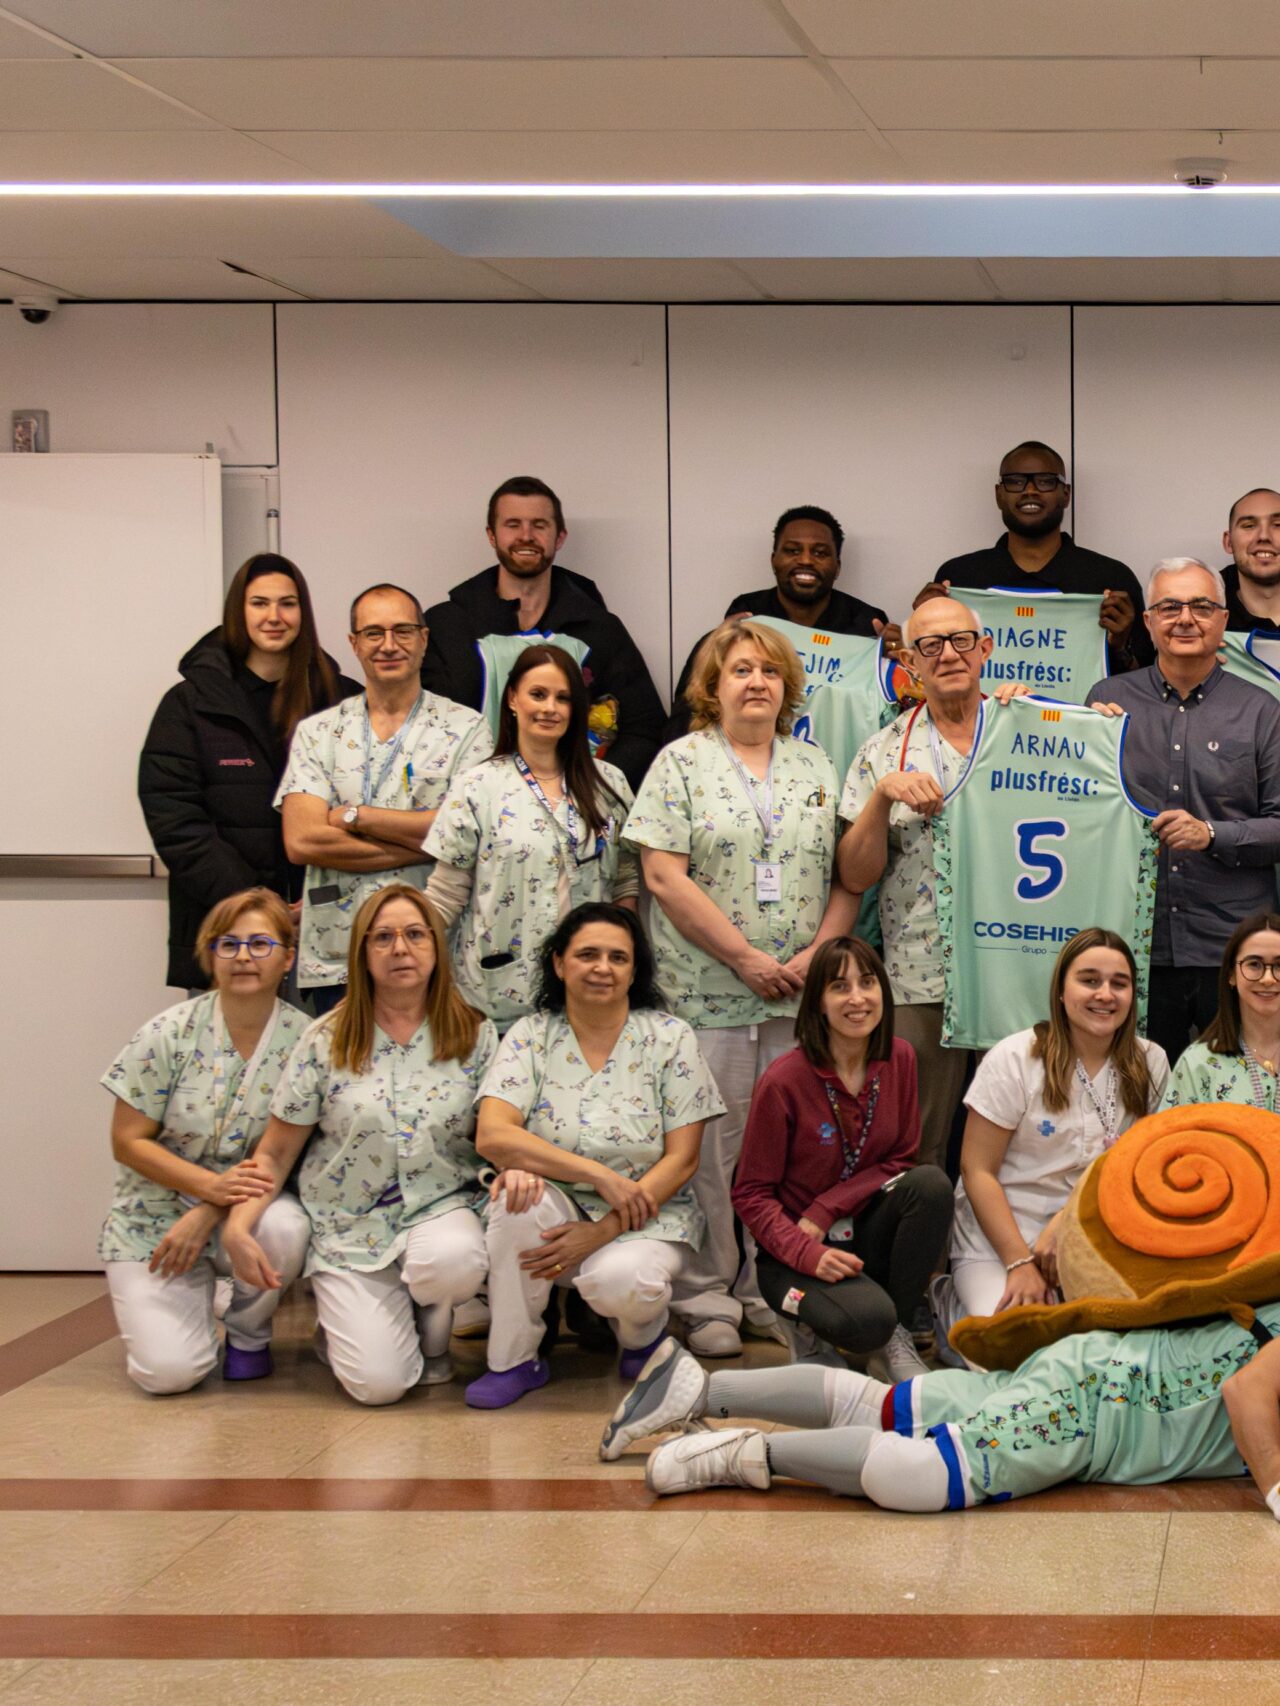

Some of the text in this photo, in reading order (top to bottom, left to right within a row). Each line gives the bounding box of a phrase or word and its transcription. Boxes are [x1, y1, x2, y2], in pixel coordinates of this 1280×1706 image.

[1010, 732, 1086, 760] ARNAU
[1016, 819, 1067, 901] 5
[1021, 945, 1047, 955] Grupo
